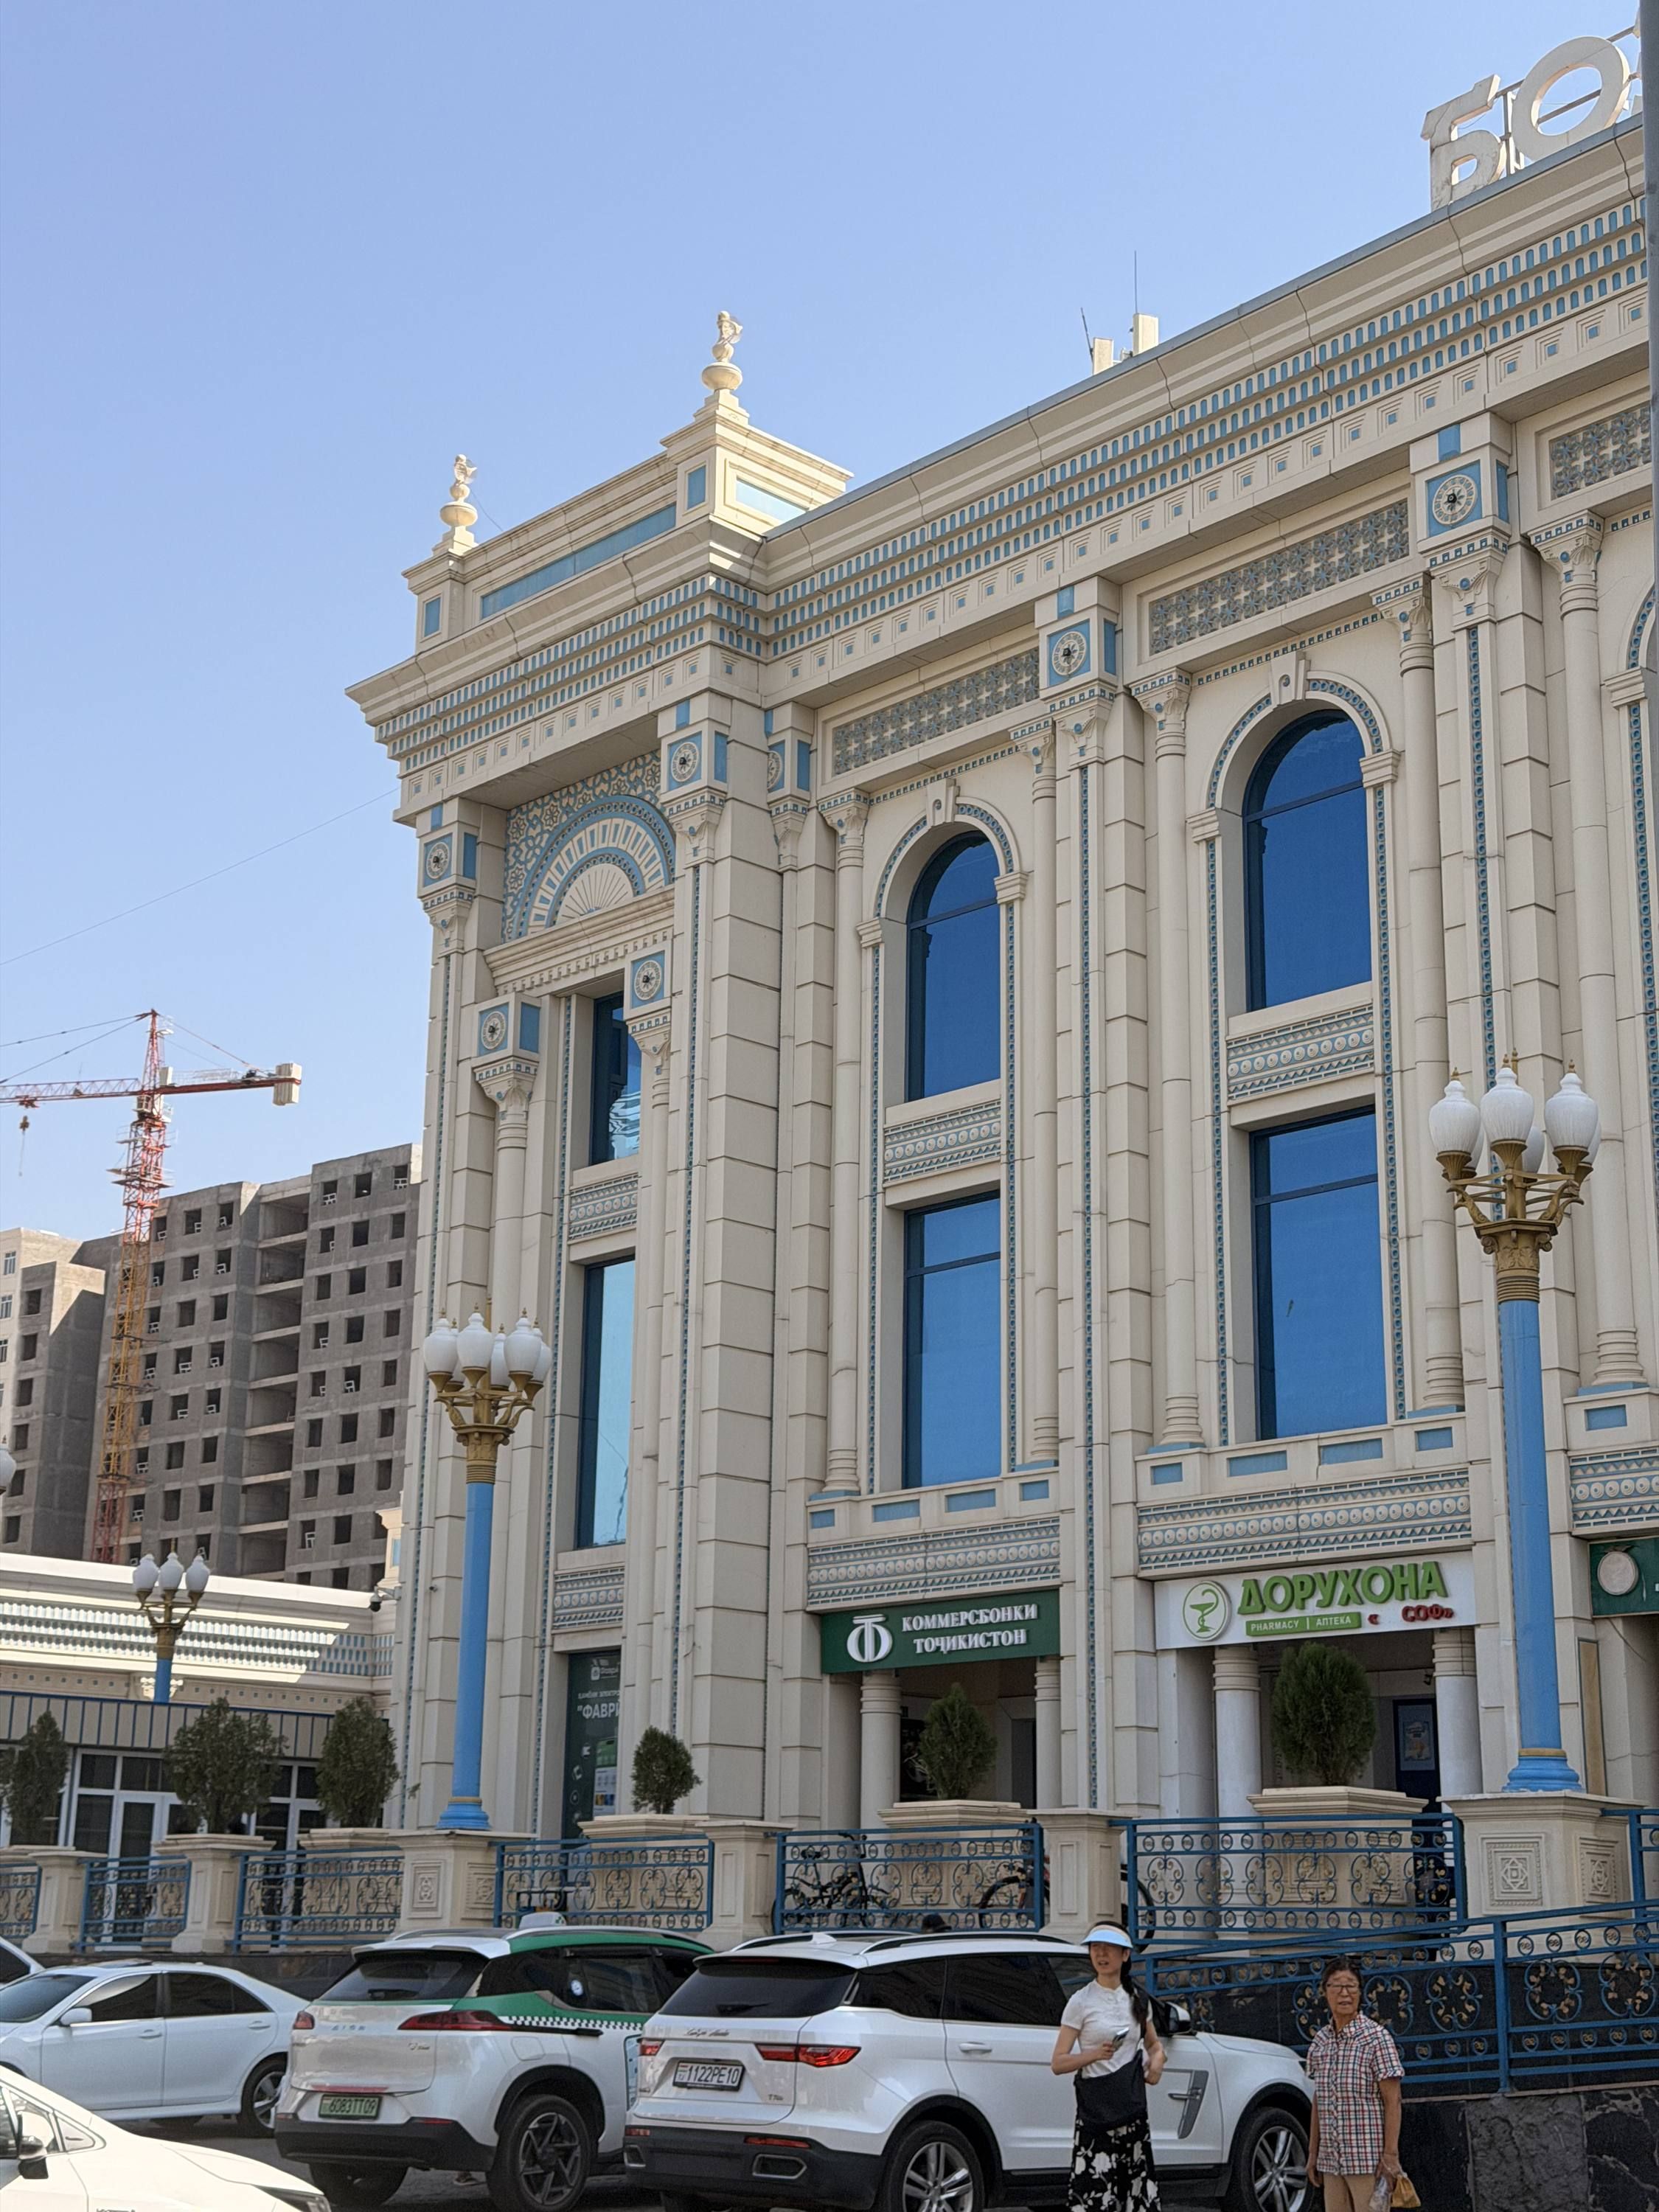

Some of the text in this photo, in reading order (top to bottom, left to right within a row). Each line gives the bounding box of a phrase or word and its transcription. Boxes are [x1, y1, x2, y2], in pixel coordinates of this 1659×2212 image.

[1420, 15, 1641, 212] БО
[1237, 1561, 1448, 1615] ДОРУХОНА
[902, 1604, 1038, 1632] КОММЕРСБОНКИ
[1251, 1620, 1299, 1631] PHARMACY
[1316, 1615, 1352, 1627] АПТЕКА
[687, 2065, 740, 2084] 1122PE10
